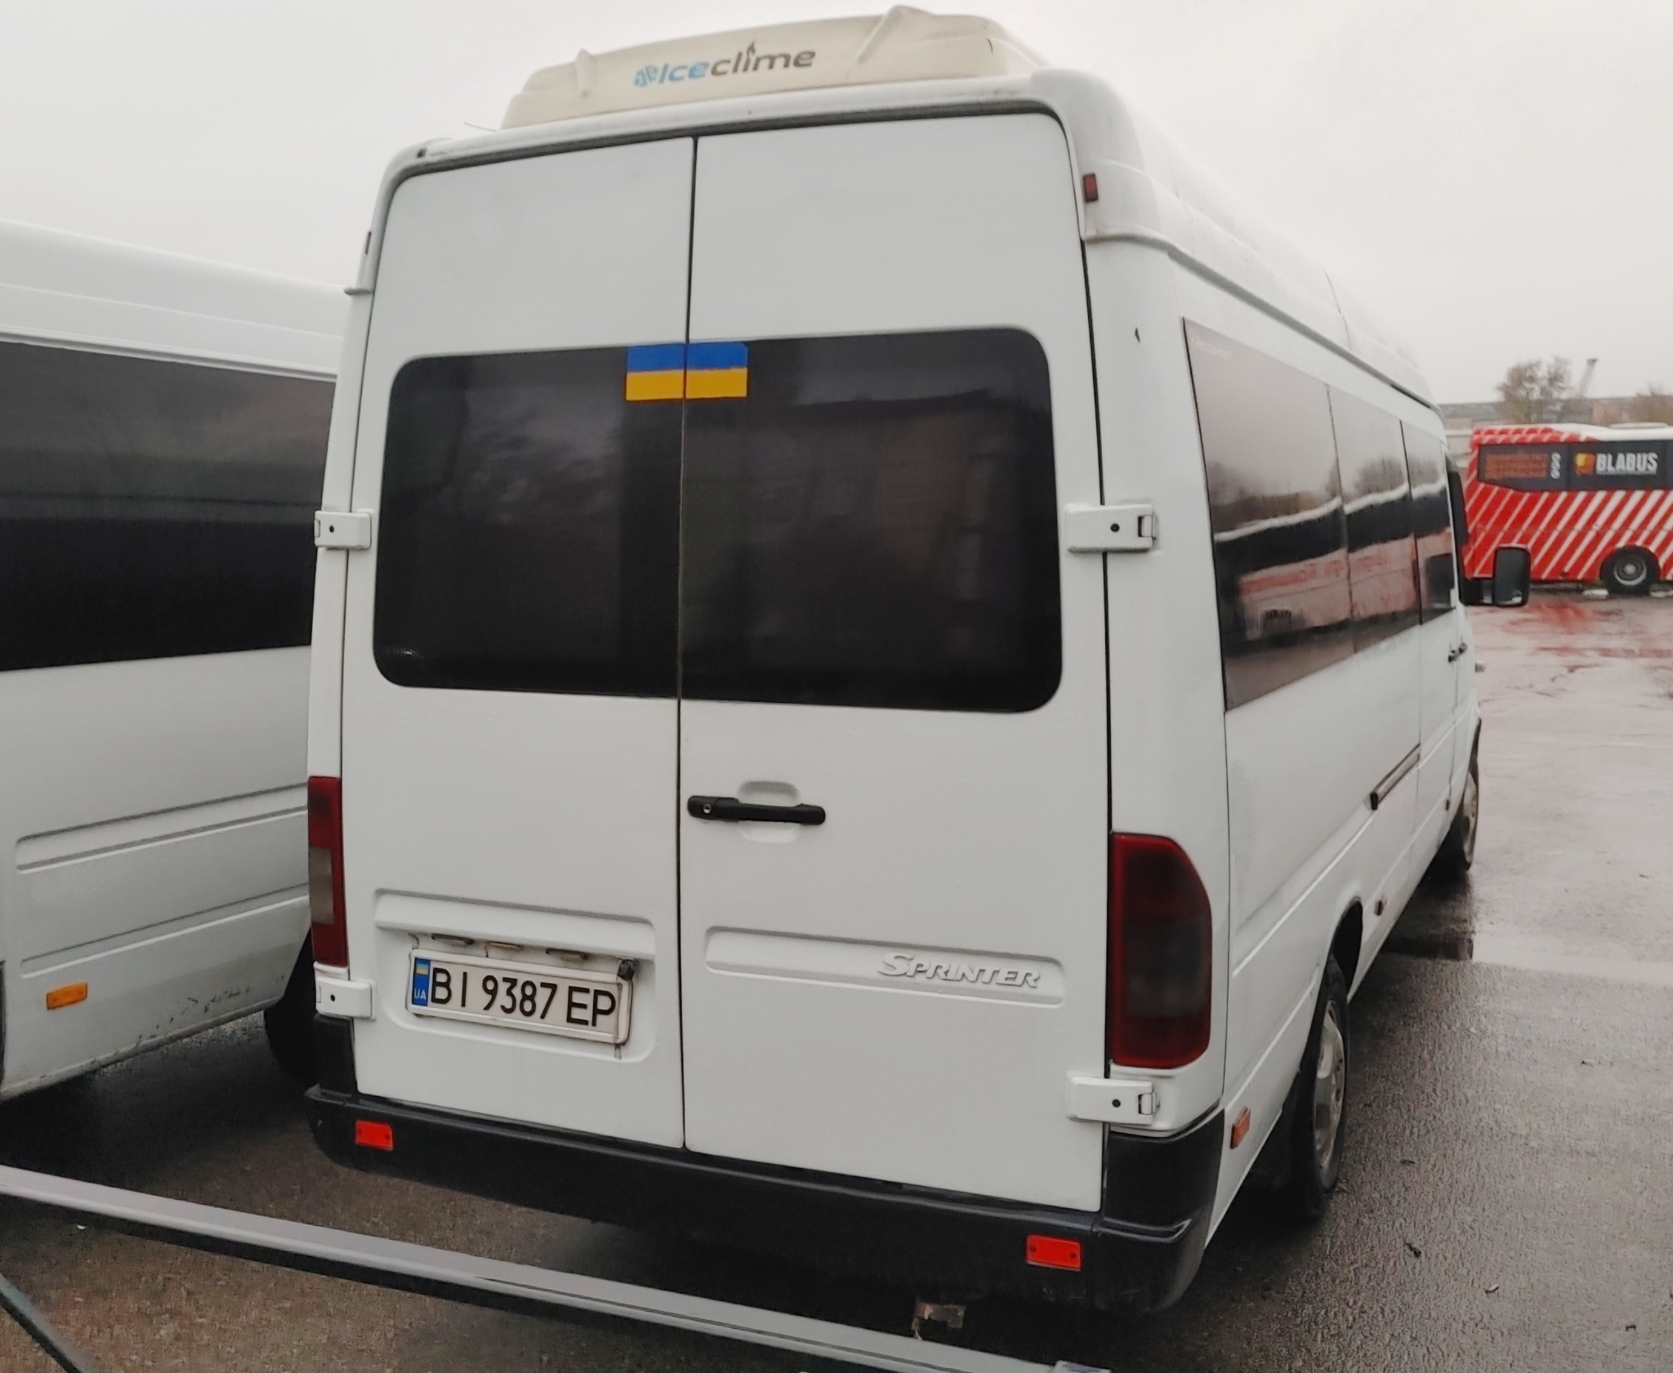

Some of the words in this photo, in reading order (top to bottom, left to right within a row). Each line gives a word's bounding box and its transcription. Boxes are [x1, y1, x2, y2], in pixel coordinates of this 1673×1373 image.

[1596, 452, 1658, 475] BLABUS
[878, 952, 1041, 988] SPRINTER
[414, 988, 426, 1001] UA
[431, 967, 467, 1007] BI
[482, 975, 558, 1020] 9387
[566, 986, 616, 1027] EP
